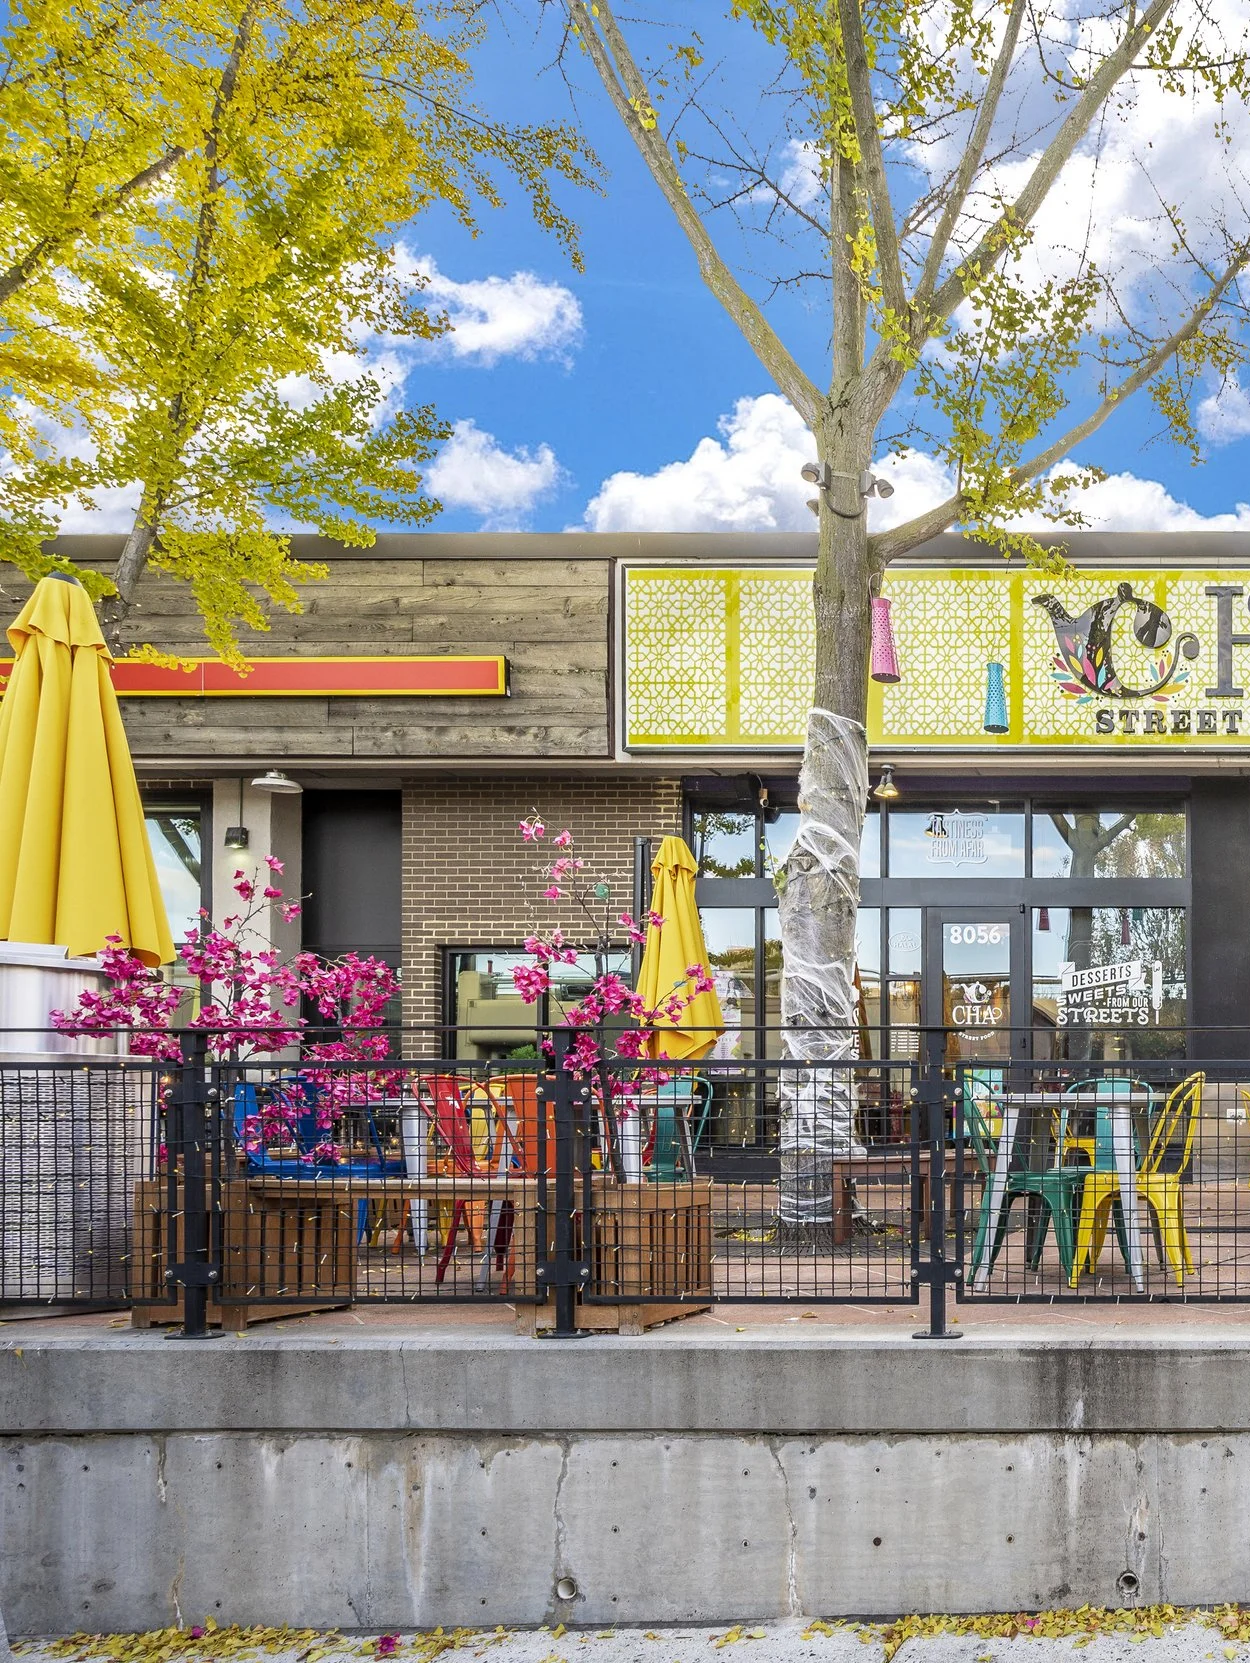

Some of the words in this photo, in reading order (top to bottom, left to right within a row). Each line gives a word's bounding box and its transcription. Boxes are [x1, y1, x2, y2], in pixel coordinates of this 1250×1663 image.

[1095, 709, 1243, 734] STREET
[932, 840, 958, 857] FROM
[960, 840, 985, 857] AFAR
[950, 925, 1000, 944] 8056
[1072, 965, 1131, 987] DESSERTS
[1056, 984, 1127, 1007] SWEETS
[1107, 997, 1130, 1007] FROM
[1132, 997, 1149, 1007] OUR
[952, 1005, 1002, 1025] CHA
[1056, 1007, 1149, 1025] STREETS
